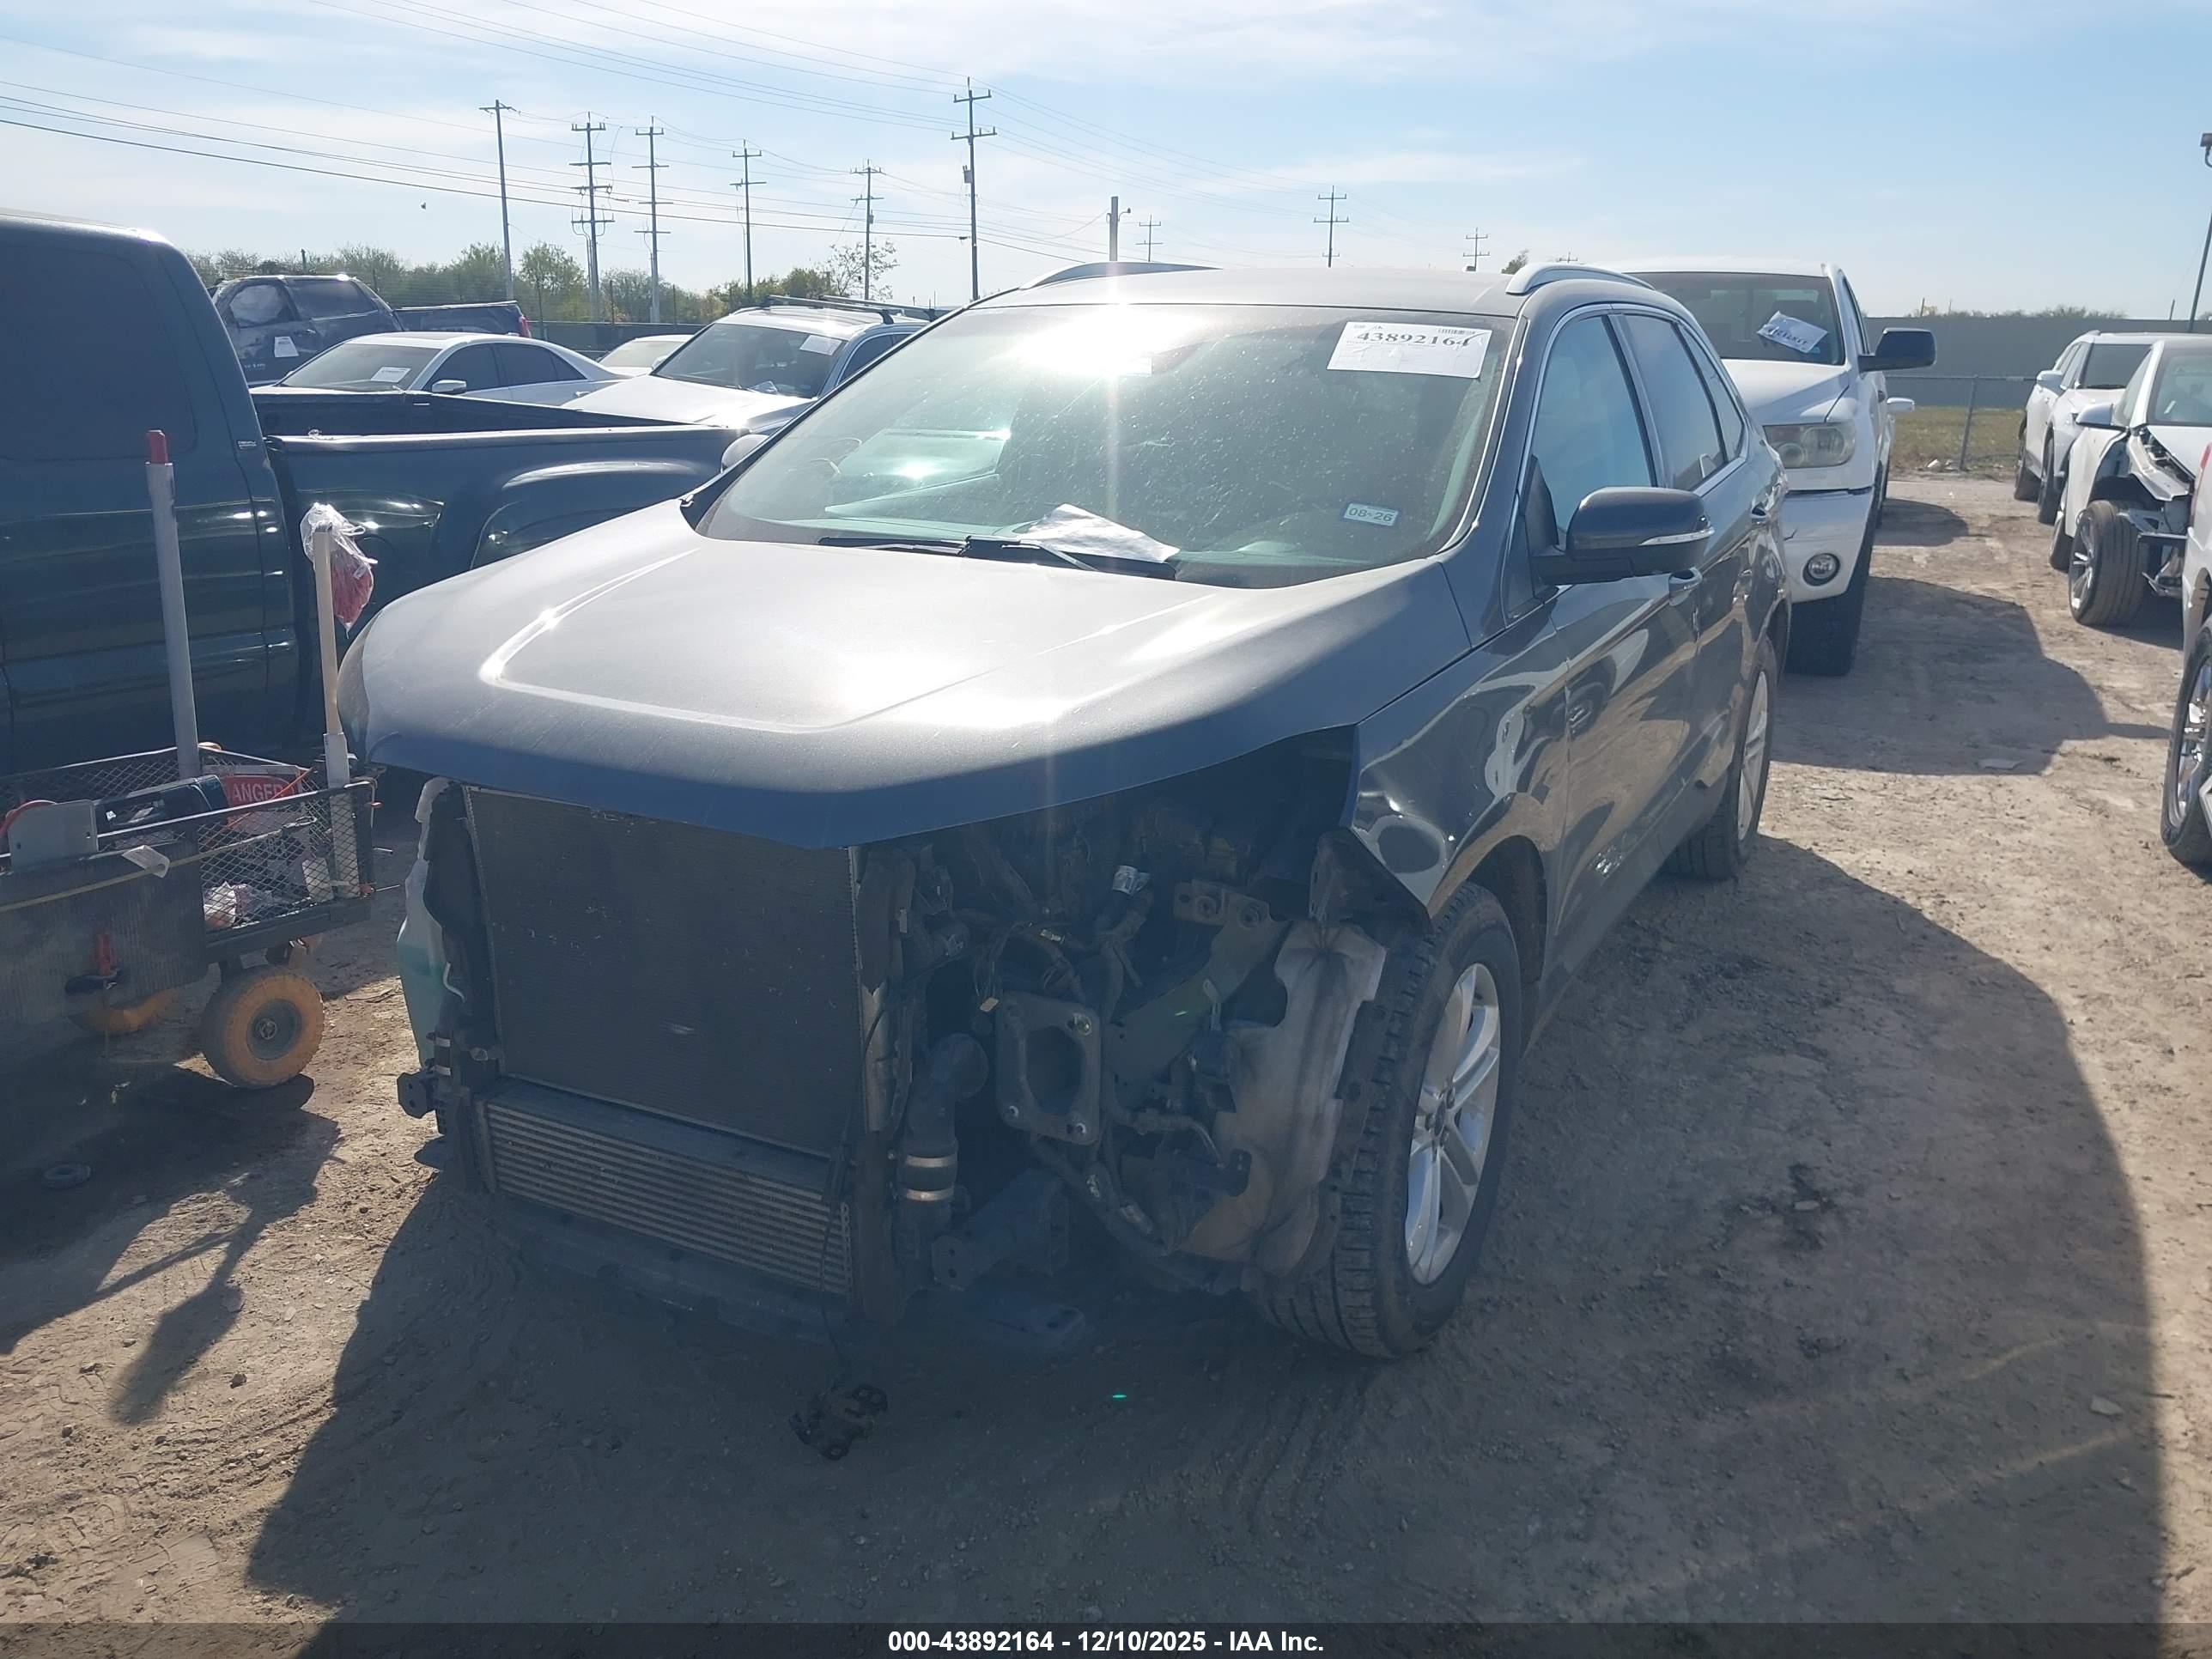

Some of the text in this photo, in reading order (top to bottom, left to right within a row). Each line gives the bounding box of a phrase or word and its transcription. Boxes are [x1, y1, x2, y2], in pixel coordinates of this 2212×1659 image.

[1357, 332, 1470, 348] 43892164
[1348, 507, 1393, 522] 08-26
[232, 782, 285, 802] ANGER
